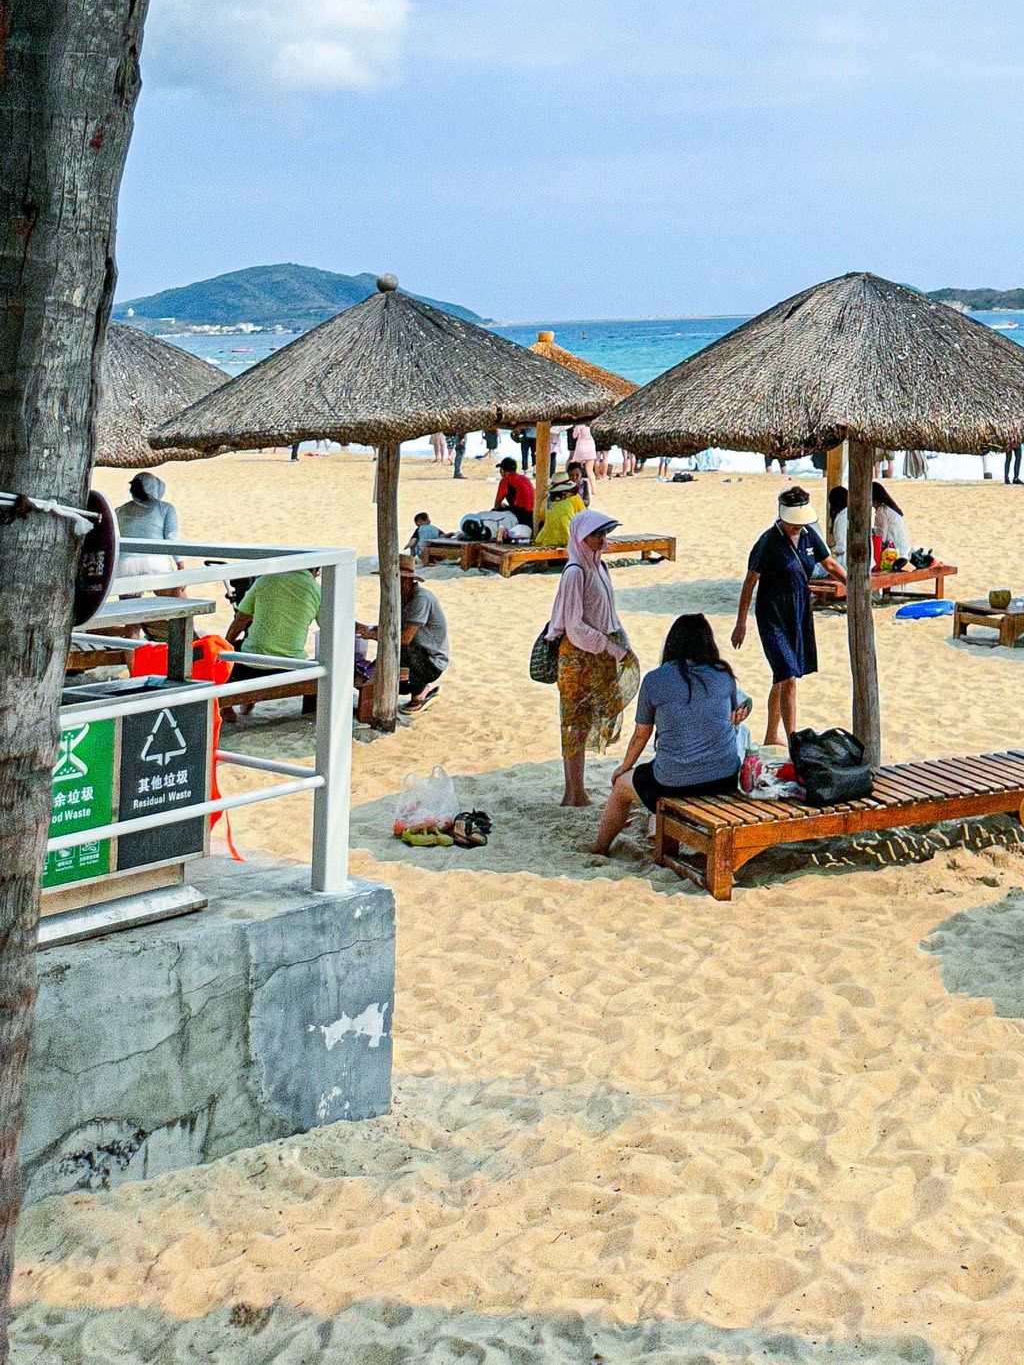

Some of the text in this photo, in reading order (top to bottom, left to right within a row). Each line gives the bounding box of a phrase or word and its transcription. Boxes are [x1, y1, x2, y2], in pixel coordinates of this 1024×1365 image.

[138, 769, 188, 793] 其他垃圾
[53, 786, 94, 807] 余垃圾
[133, 790, 192, 809] Residual Waste
[51, 807, 91, 824] od Waste
